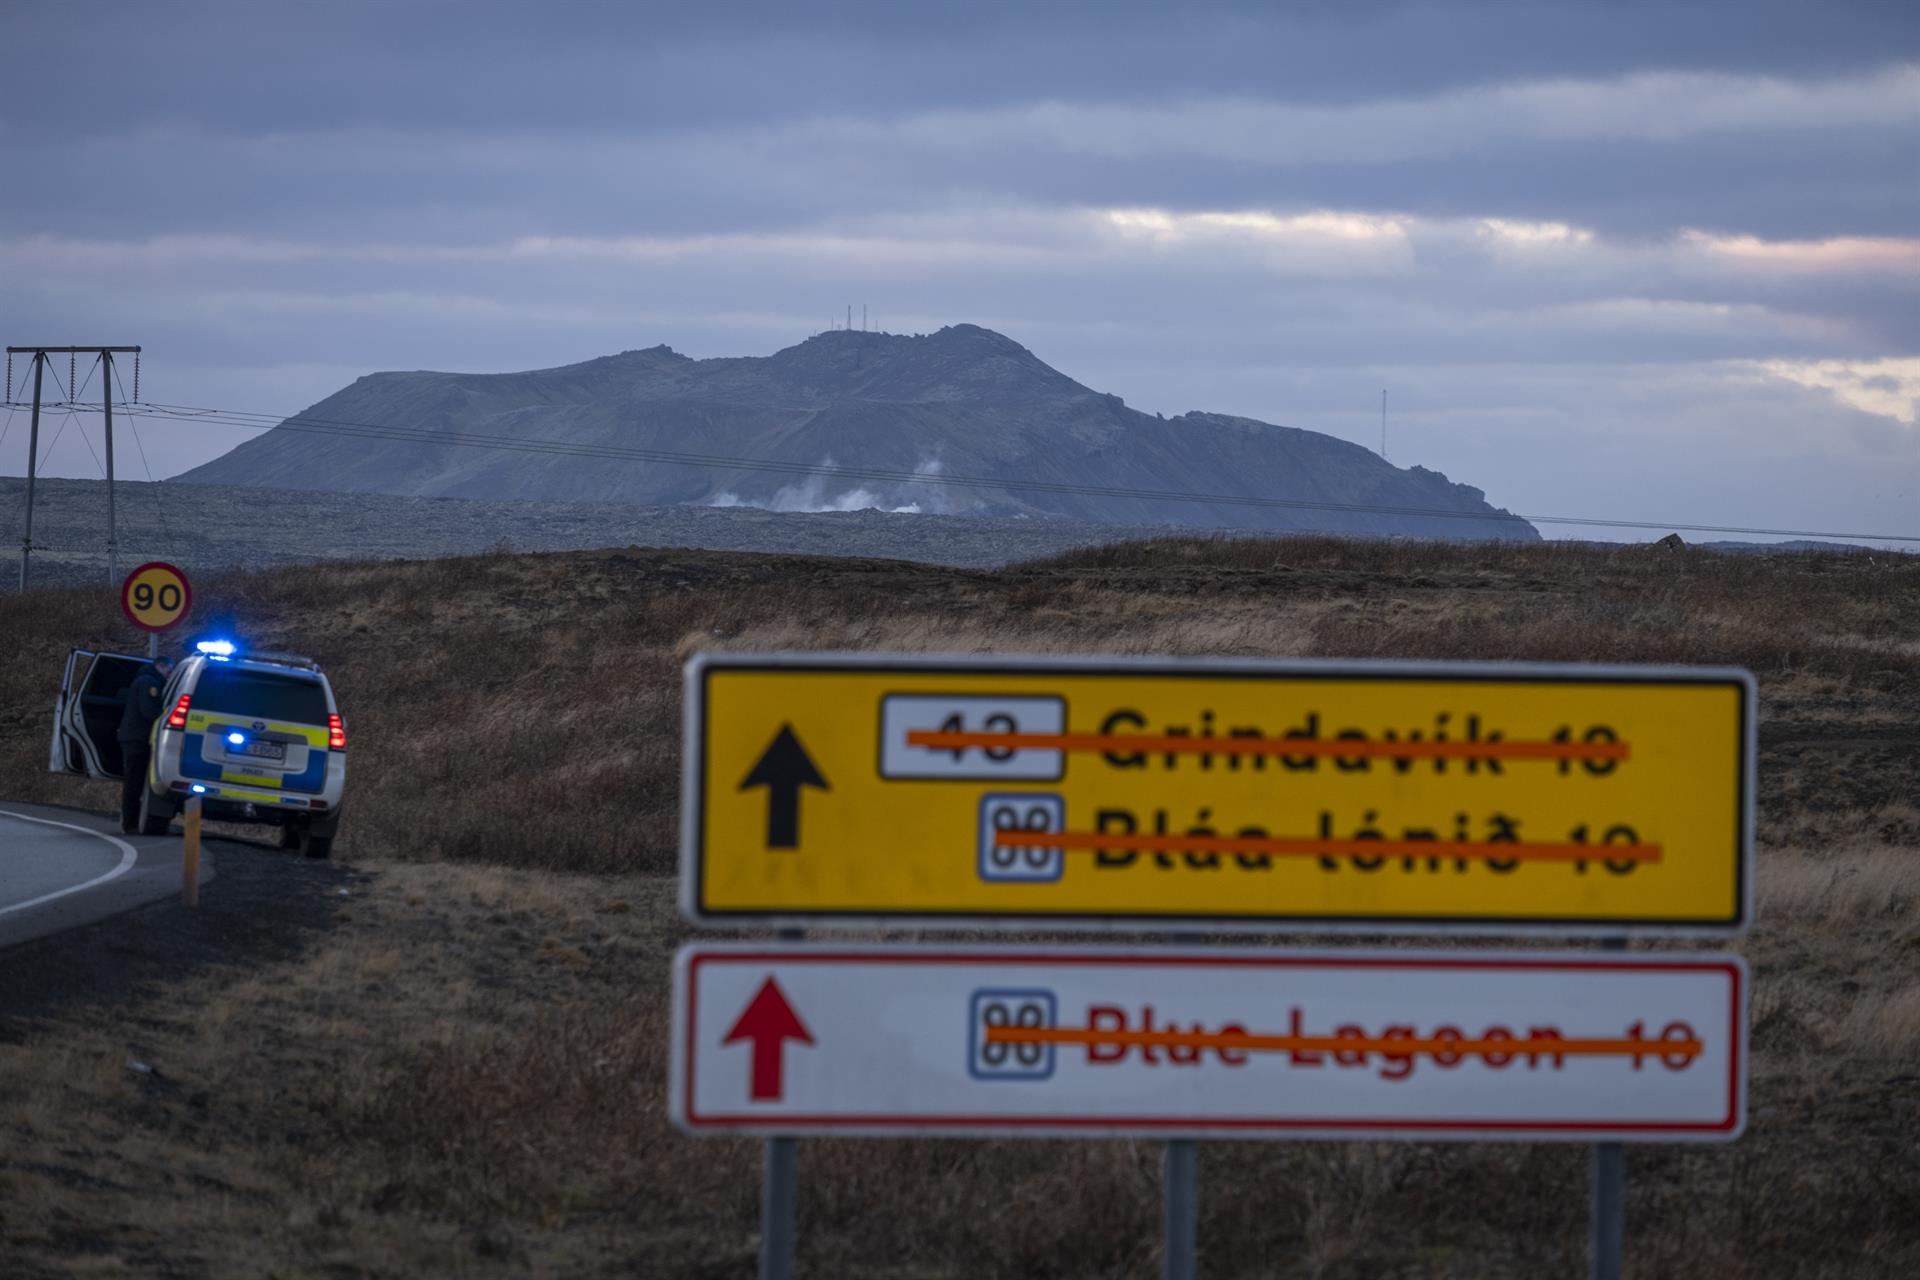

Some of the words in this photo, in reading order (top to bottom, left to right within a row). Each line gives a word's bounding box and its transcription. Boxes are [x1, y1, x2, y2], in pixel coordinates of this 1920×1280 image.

[133, 582, 182, 612] 90
[926, 710, 1018, 763] 43
[1100, 709, 1506, 775] Grindavík
[1552, 724, 1619, 776] 10
[1095, 809, 1273, 871] Bláa
[1319, 810, 1523, 874] lónið
[1567, 823, 1641, 875] 10
[1085, 1005, 1248, 1066] Blue
[1289, 1006, 1564, 1081] Lagoon
[1625, 1019, 1696, 1072] 10
